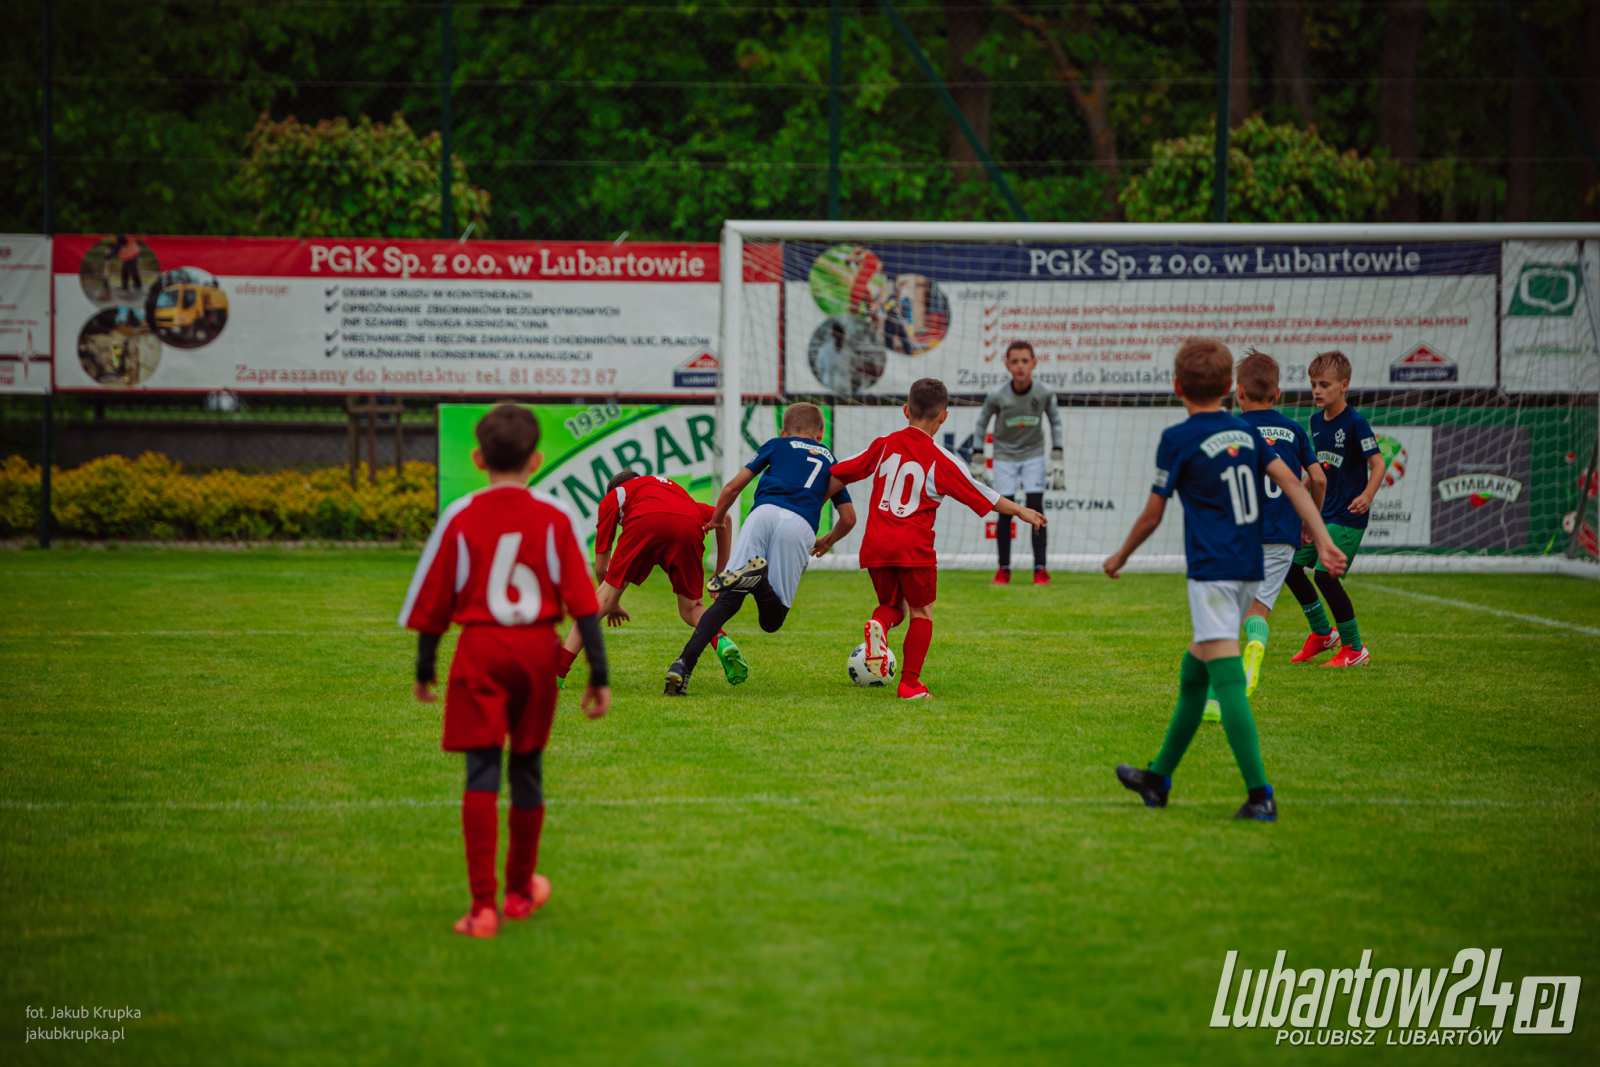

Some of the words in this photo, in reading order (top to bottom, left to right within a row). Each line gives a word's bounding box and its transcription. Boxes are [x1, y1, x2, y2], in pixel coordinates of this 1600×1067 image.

[311, 245, 378, 273] PGK
[382, 246, 427, 280] Sp.
[431, 254, 447, 273] z
[452, 254, 502, 275] o.o.
[508, 255, 534, 275] w
[540, 249, 705, 277] Lubartowie
[1029, 249, 1094, 275] PGK
[1100, 248, 1143, 281] Sp.
[1149, 254, 1163, 274] z
[1168, 254, 1217, 274] o.o.
[1223, 254, 1248, 274] w
[1256, 246, 1421, 273] Lubartowie
[235, 363, 348, 385] Zapraszamy
[353, 364, 376, 382] do
[1072, 368, 1097, 385] do
[1100, 368, 1175, 385] kontakt
[565, 403, 622, 438] 1930
[803, 456, 823, 489] 7
[878, 452, 926, 518] 10
[1443, 479, 1516, 497] TYMBARK
[1219, 464, 1260, 526] 10
[487, 531, 543, 627] 6
